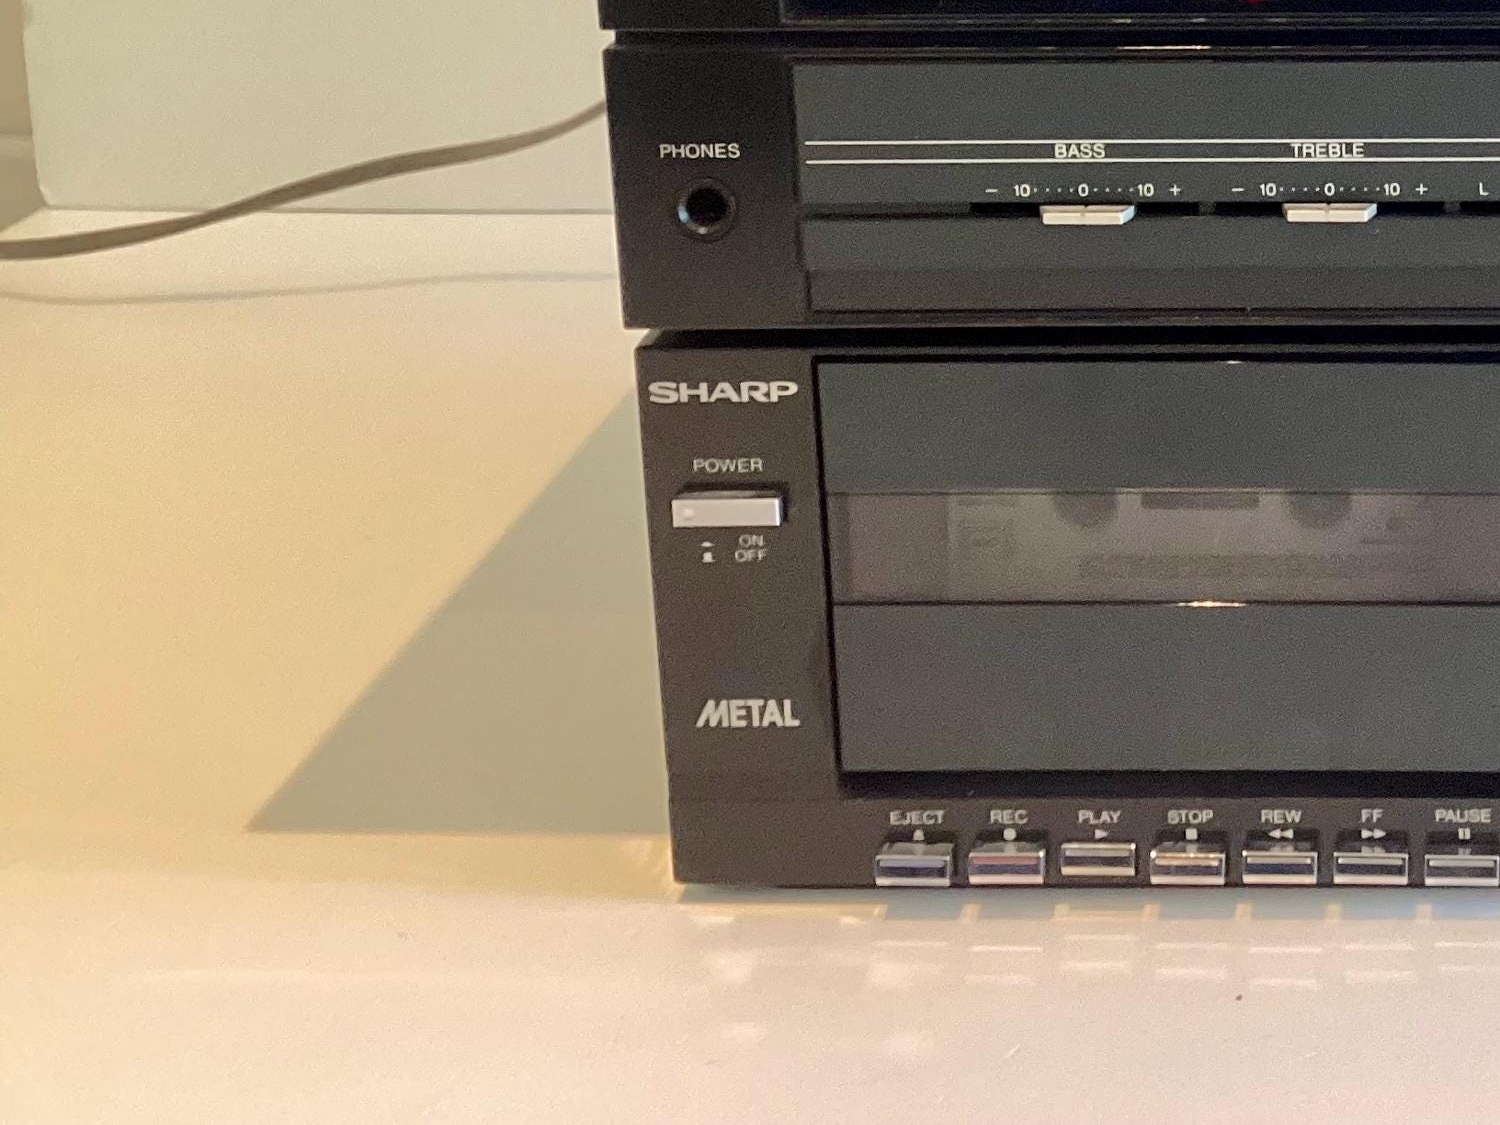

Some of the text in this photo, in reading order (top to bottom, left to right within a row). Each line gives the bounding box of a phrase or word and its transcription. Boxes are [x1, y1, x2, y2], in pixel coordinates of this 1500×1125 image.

[659, 142, 741, 159] PHONES
[1054, 142, 1106, 160] BASS
[1290, 142, 1365, 159] TREBLE
[1013, 183, 1155, 198] 10 10
[1259, 182, 1400, 197] 10 10
[648, 380, 799, 404] SHARP
[692, 457, 763, 473] POWER
[739, 534, 763, 546] ON
[735, 549, 768, 562] OFF
[696, 698, 801, 728] METAL
[889, 809, 945, 826] EJECT
[991, 811, 1028, 825] REC
[1078, 809, 1121, 825] PLAY
[1168, 810, 1213, 825] STOP
[1260, 809, 1302, 824] REW
[1361, 808, 1383, 823] FF
[1434, 808, 1492, 824] PAUSE
